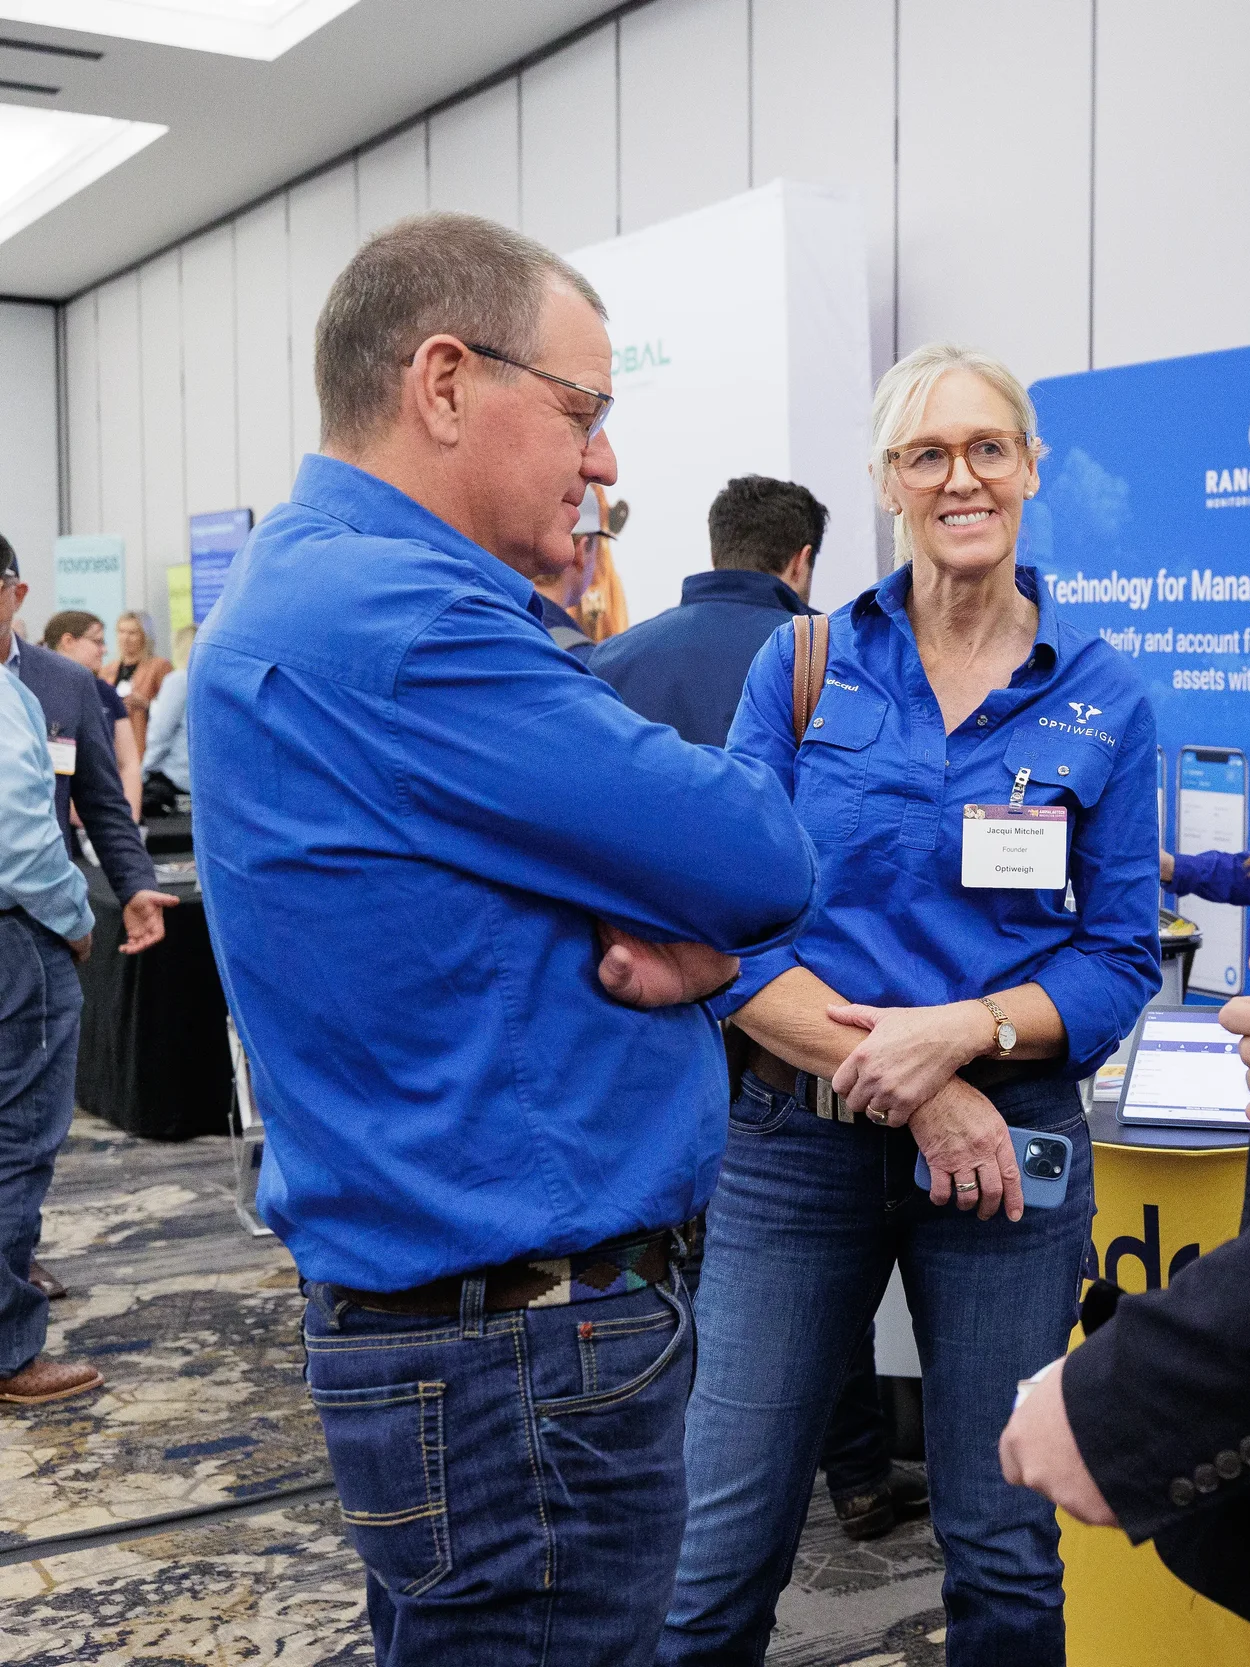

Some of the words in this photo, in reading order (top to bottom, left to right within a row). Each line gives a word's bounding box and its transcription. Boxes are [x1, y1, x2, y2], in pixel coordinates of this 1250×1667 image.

[1044, 569, 1153, 610] Technology
[1157, 567, 1187, 602] for
[1099, 626, 1142, 658] Verify
[1144, 626, 1173, 653] and
[1176, 630, 1241, 655] account
[1173, 667, 1225, 691] assets
[1038, 717, 1116, 747] OPTIWEIGH
[986, 827, 1013, 836] Jacqui
[1014, 827, 1045, 836] Mitchell
[994, 864, 1034, 874] Optiweigh
